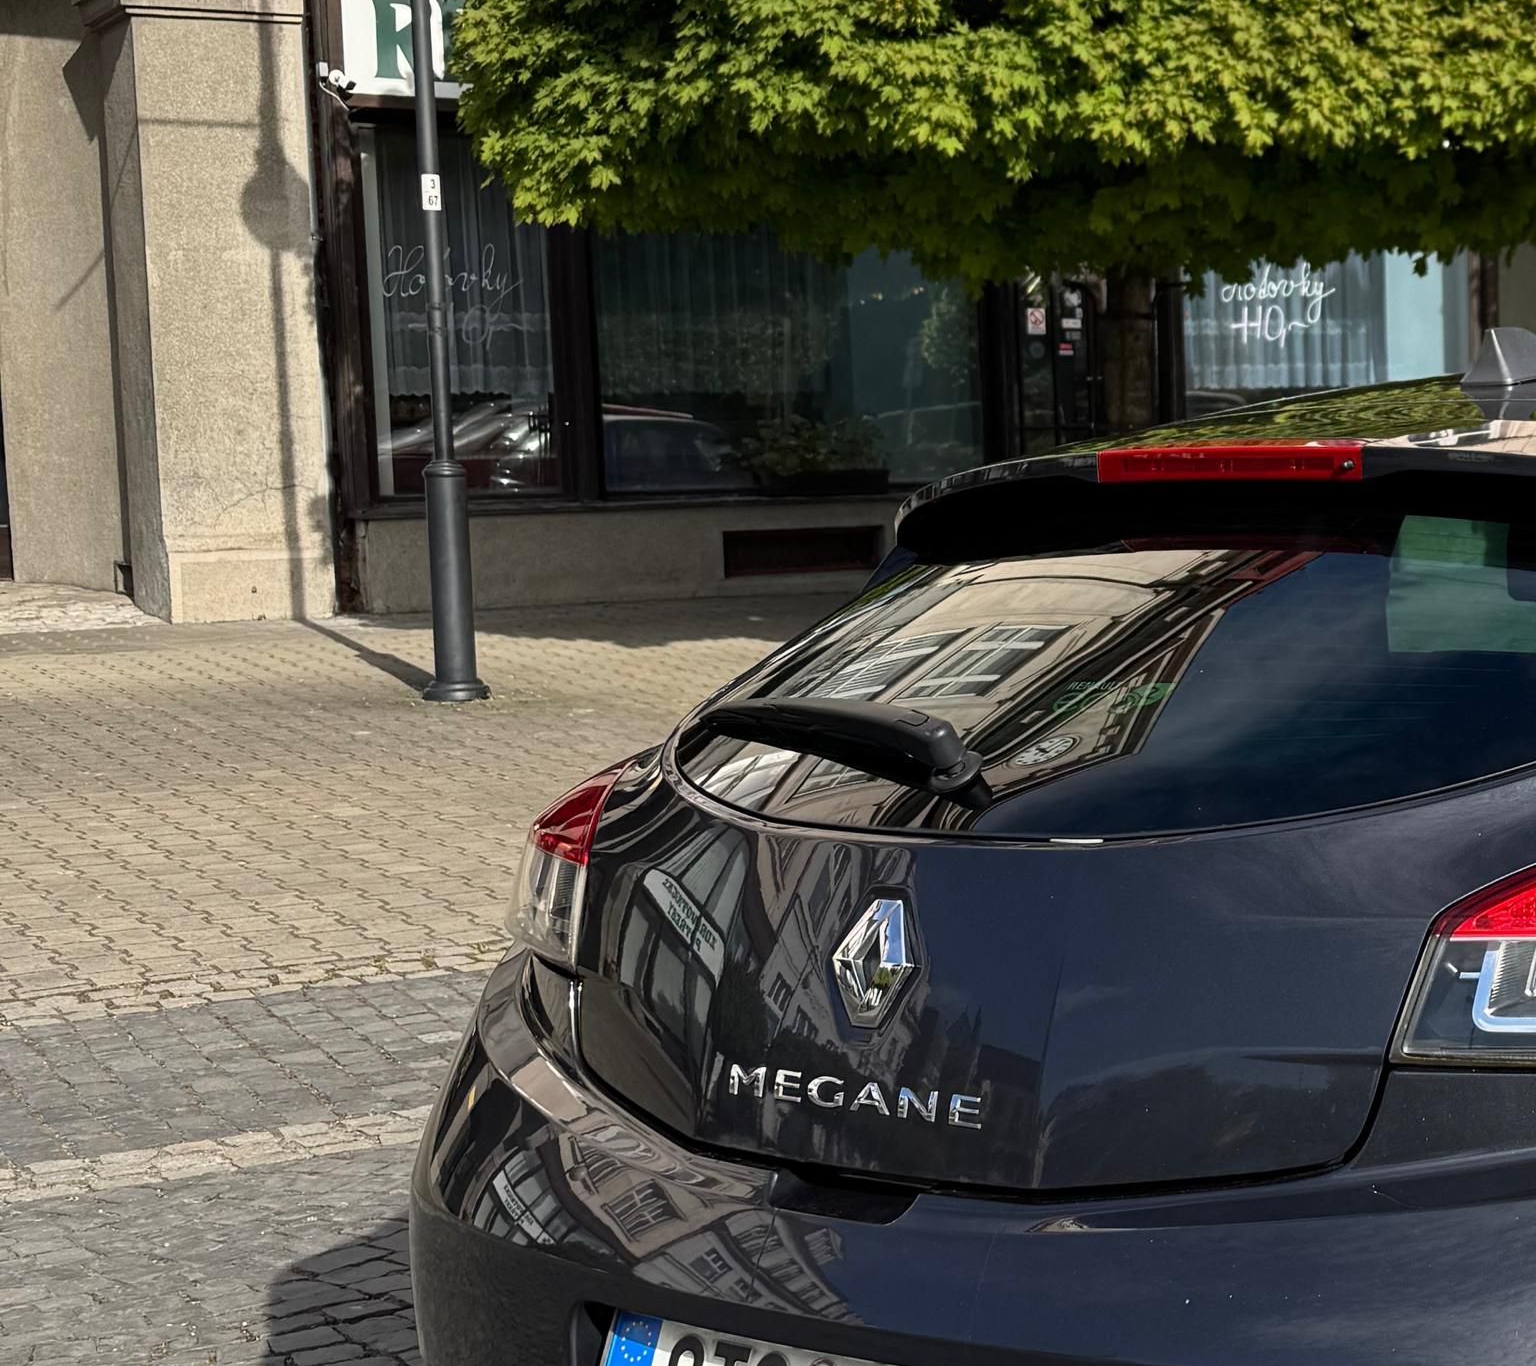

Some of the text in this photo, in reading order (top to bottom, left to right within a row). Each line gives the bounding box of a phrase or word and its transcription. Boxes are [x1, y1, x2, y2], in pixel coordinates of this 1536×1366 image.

[430, 178, 436, 189] 3
[428, 195, 438, 206] 67
[729, 1063, 982, 1129] MEGANE
